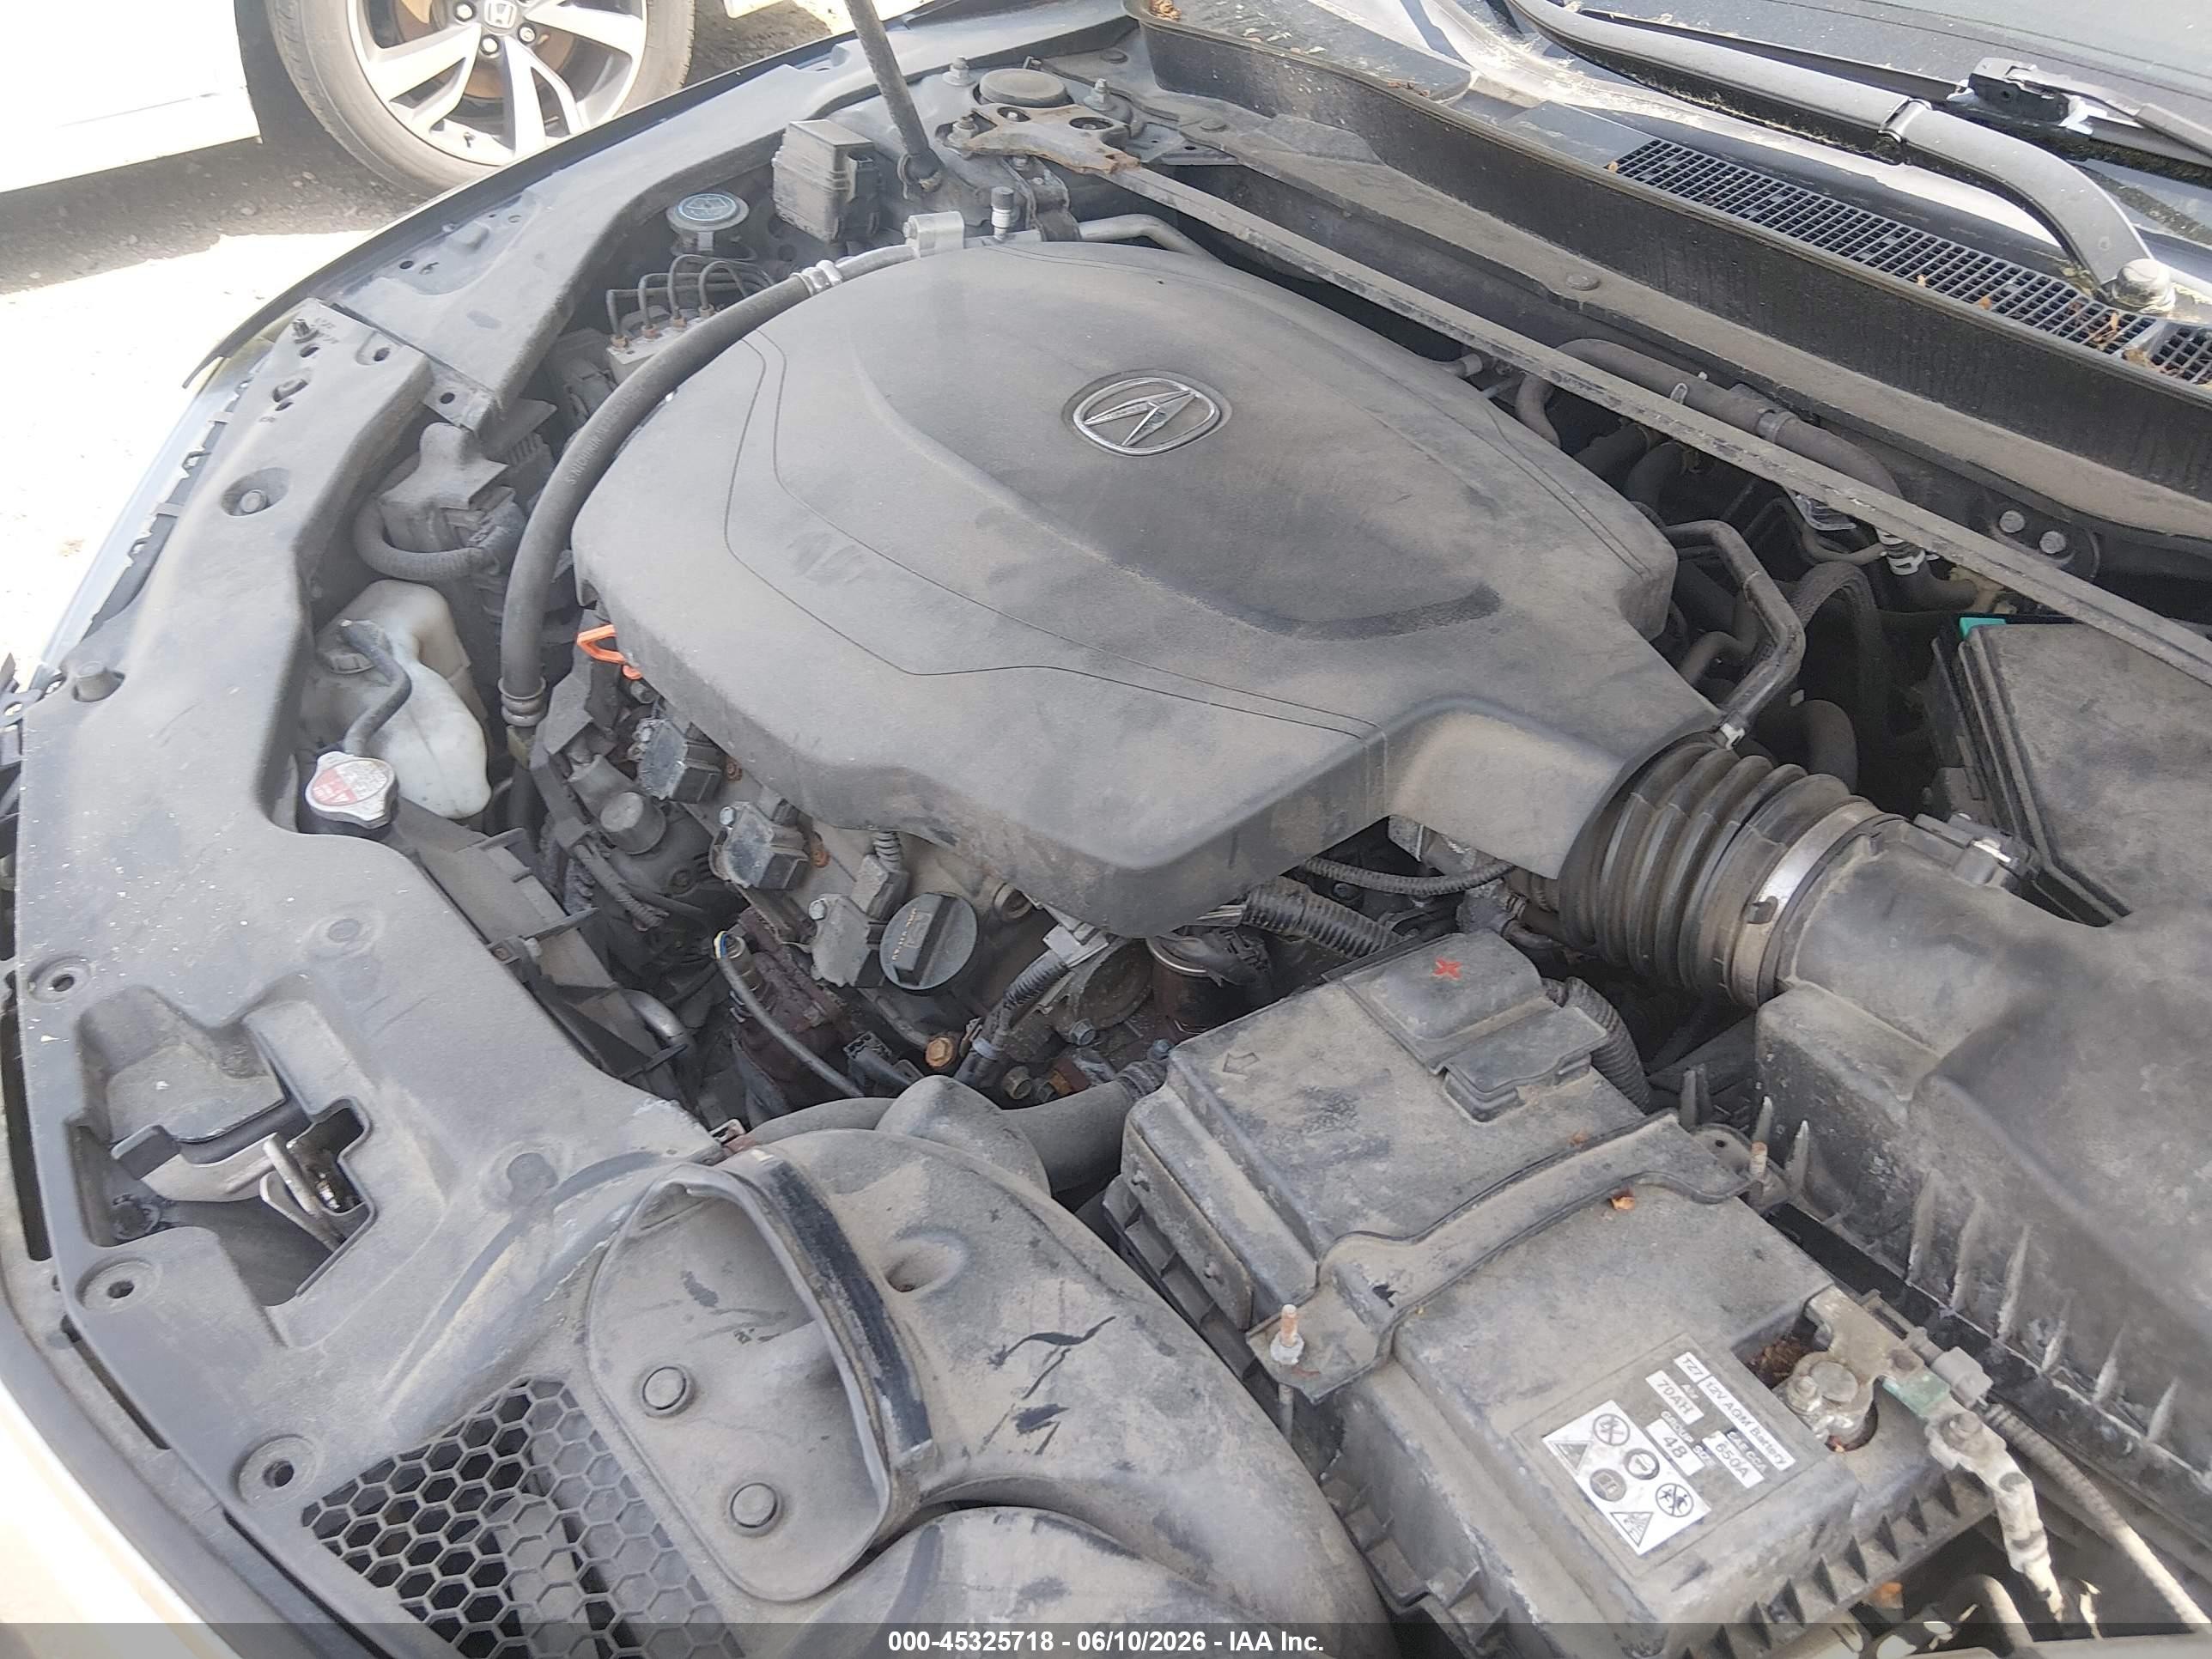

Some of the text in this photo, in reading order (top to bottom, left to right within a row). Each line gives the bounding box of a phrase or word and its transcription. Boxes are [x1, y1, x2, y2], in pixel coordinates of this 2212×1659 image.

[1656, 1379, 1693, 1413] 70AH
[1705, 1382, 1787, 1466] 12V AGM Battery
[1662, 1437, 1688, 1458] 48
[1715, 1443, 1750, 1479] 650A
